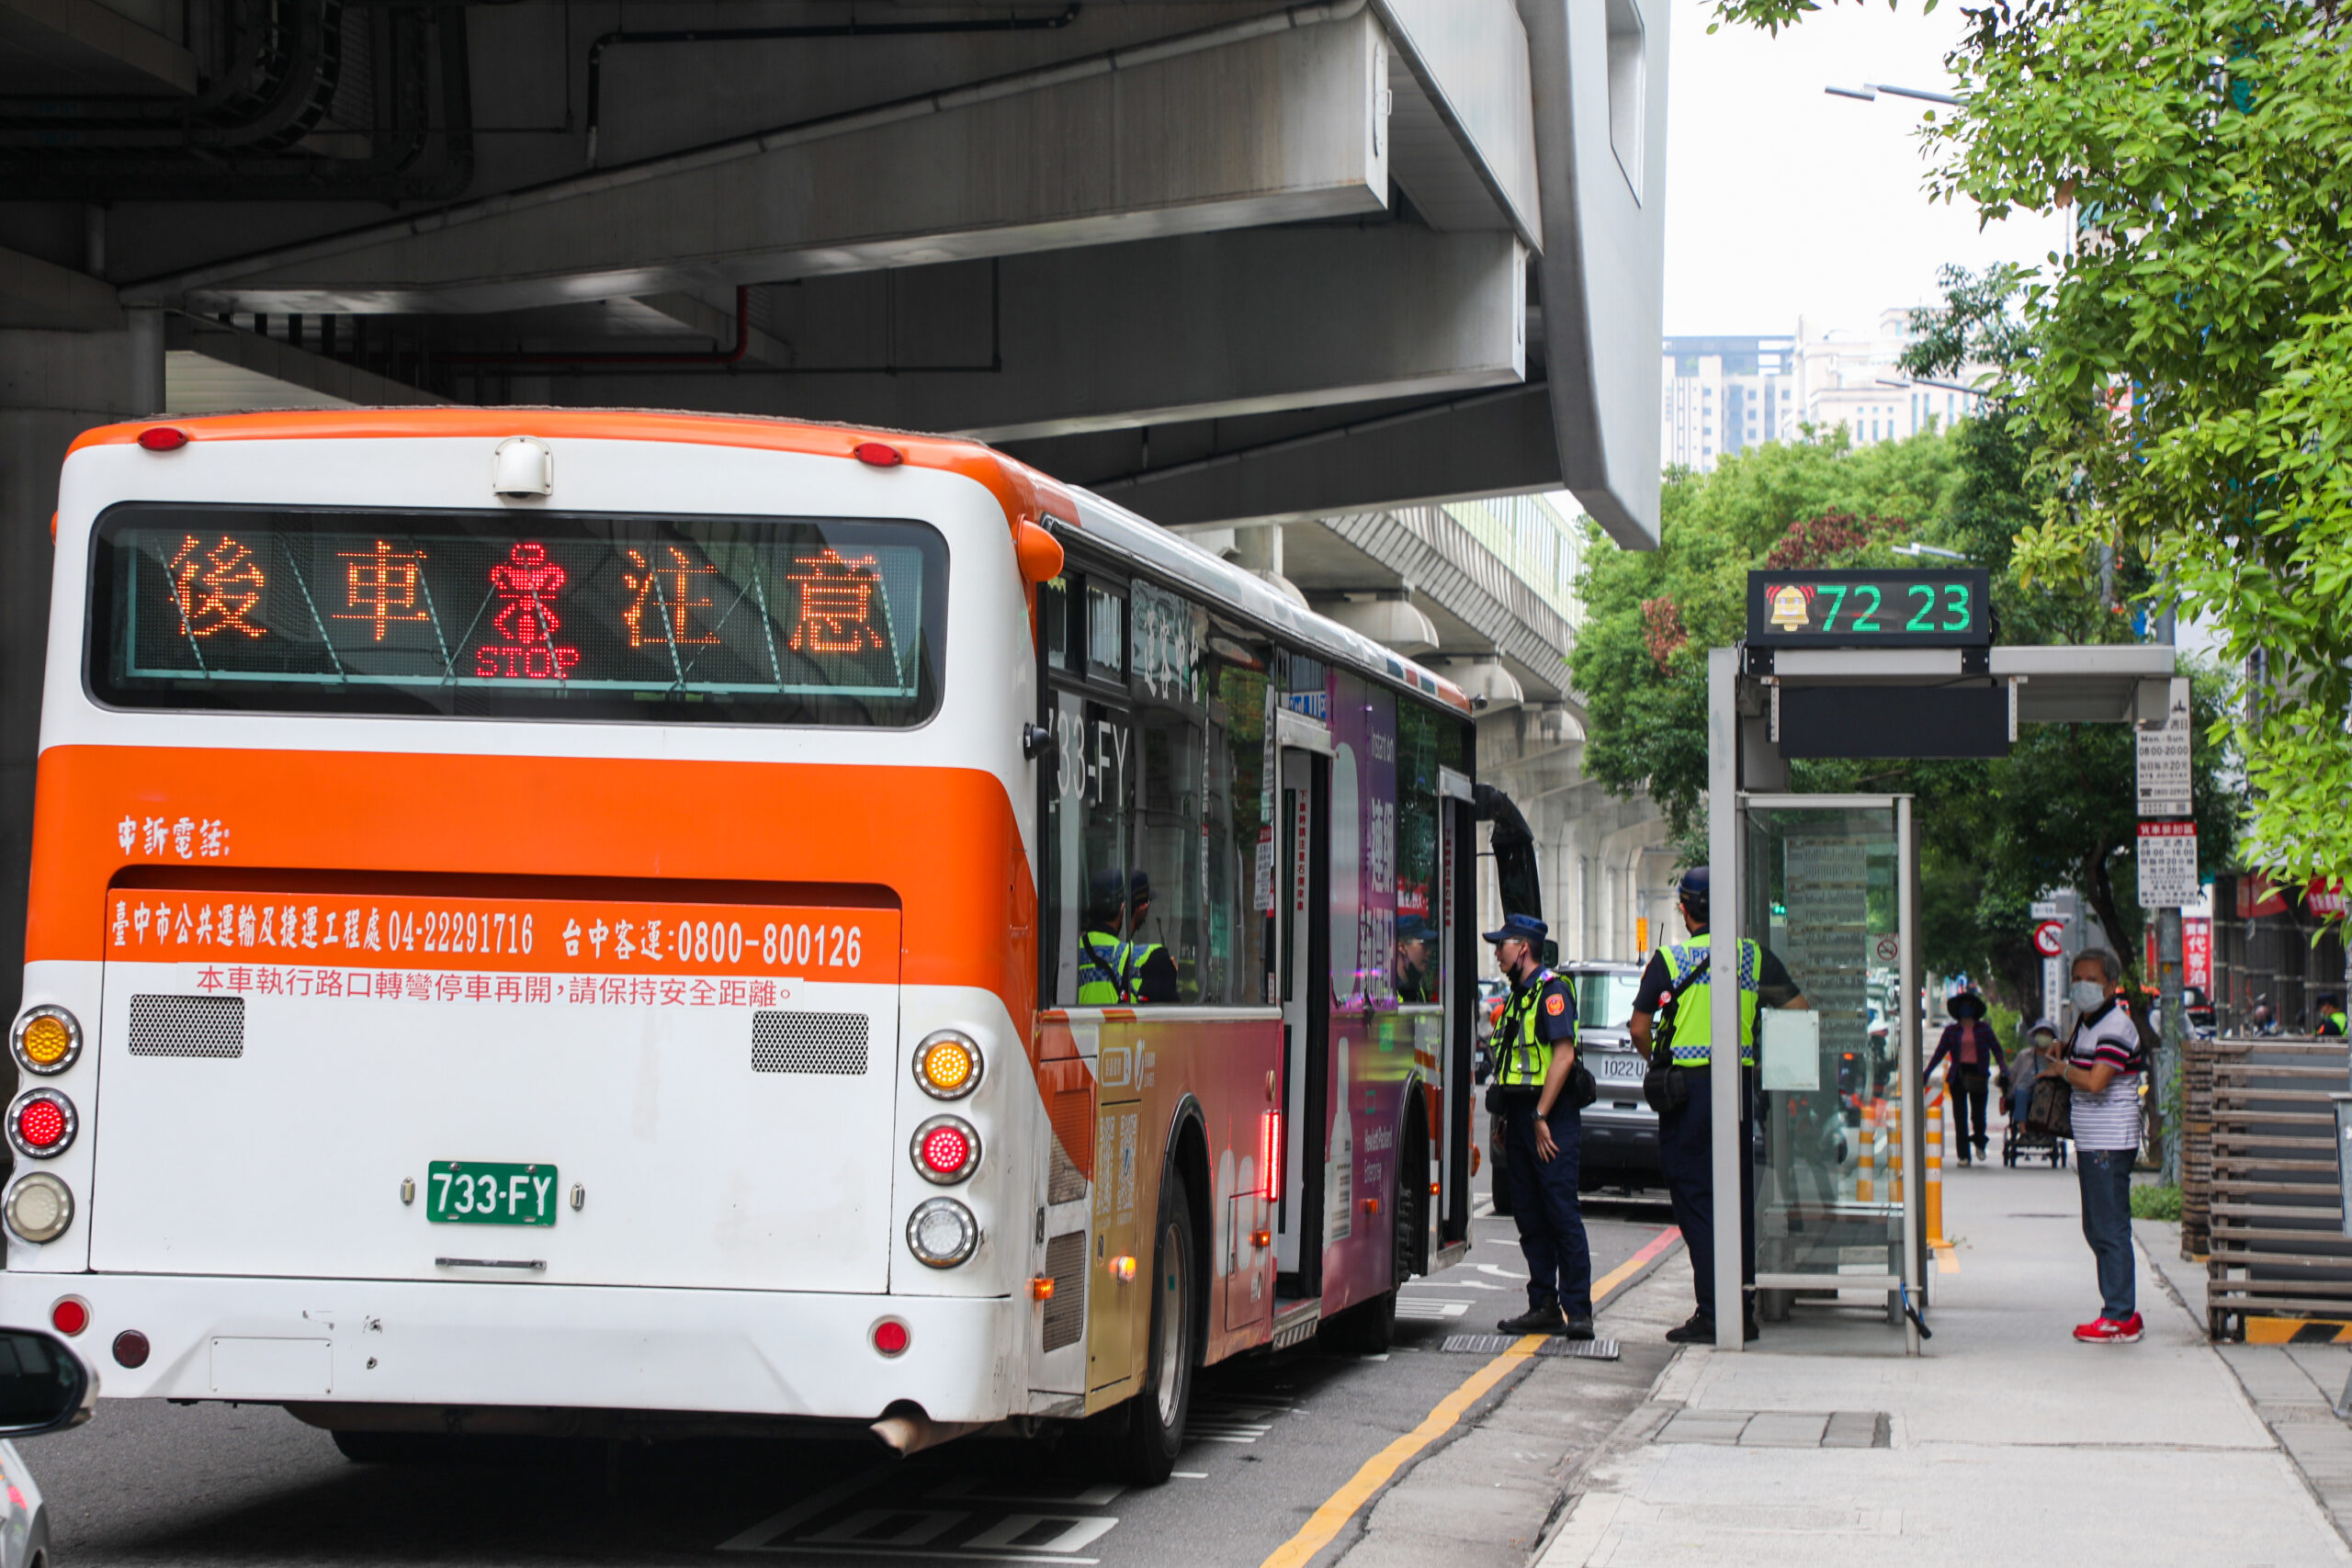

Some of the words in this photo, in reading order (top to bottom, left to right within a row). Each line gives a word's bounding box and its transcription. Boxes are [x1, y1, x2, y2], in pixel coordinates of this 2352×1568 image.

[1816, 584, 1882, 632] 72
[1905, 584, 1970, 632] 23
[476, 647, 581, 680] STOP
[112, 899, 382, 952] 臺中市公共運輸及捷運工程處
[389, 910, 533, 954] 04-22291716
[2188, 936, 2207, 992] 代客泊
[433, 1173, 552, 1216] 733-FY
